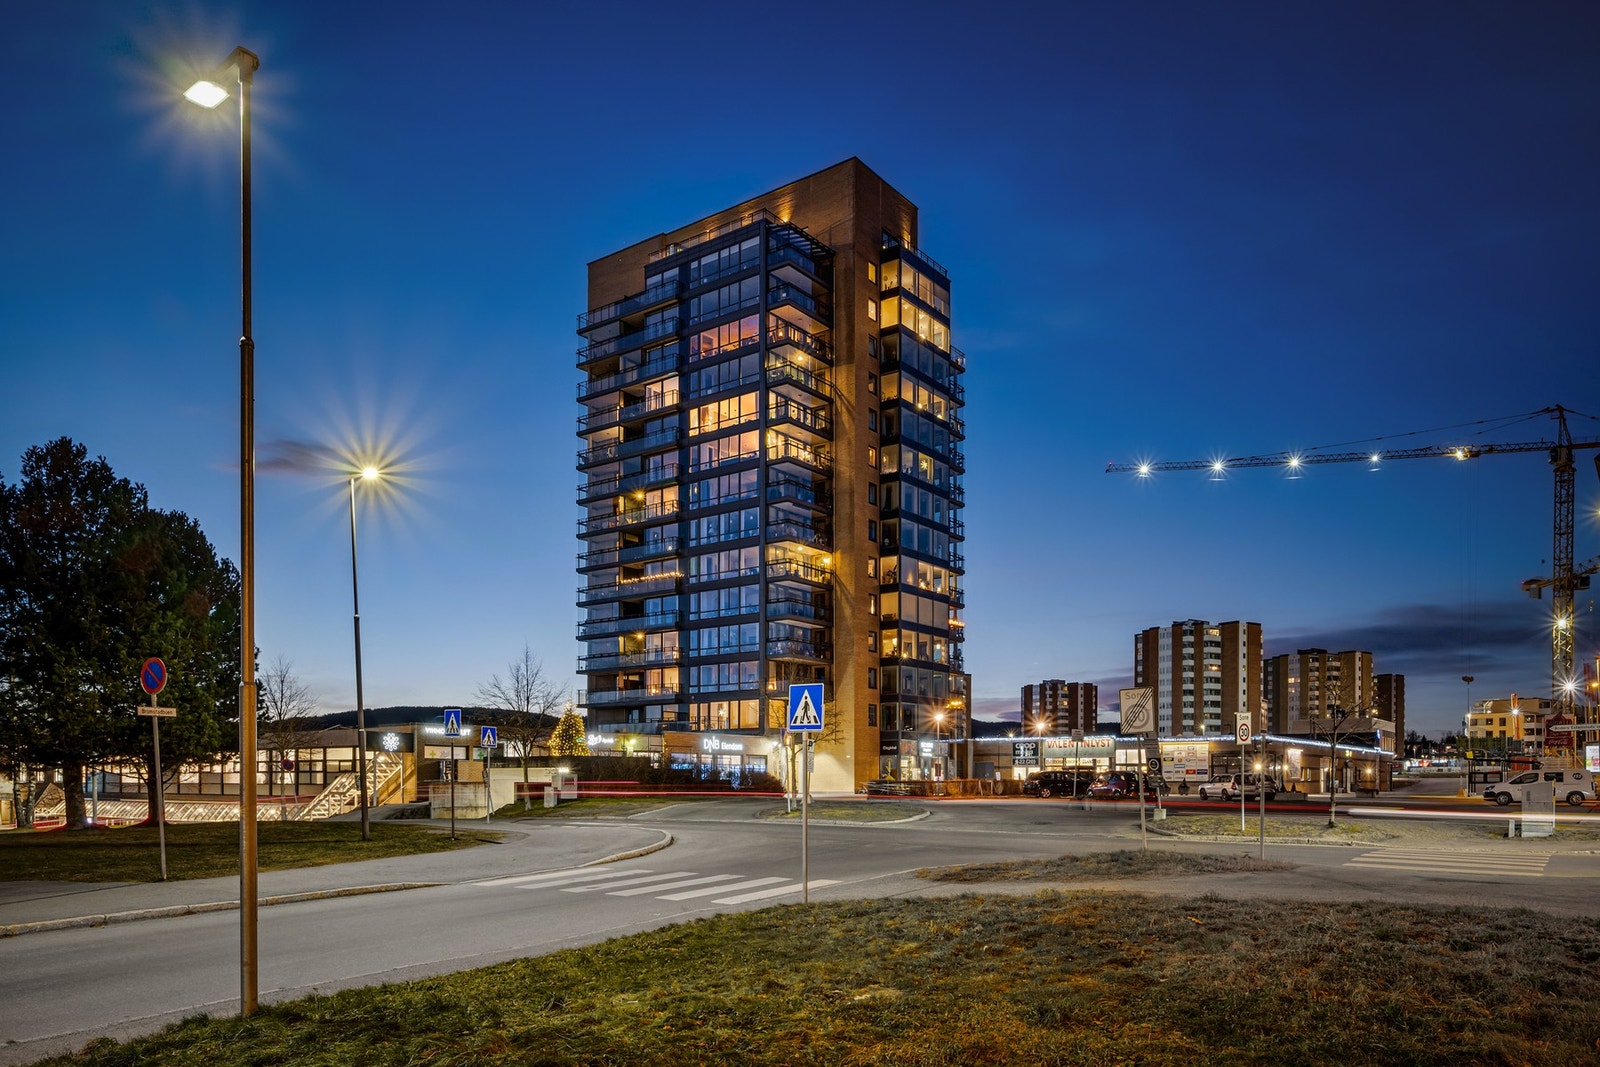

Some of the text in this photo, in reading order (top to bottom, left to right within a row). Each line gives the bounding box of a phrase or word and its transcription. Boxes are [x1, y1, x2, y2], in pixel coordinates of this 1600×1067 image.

[1240, 727, 1248, 738] 30
[703, 736, 720, 752] DNB
[1047, 739, 1111, 749] VALENINLYST
